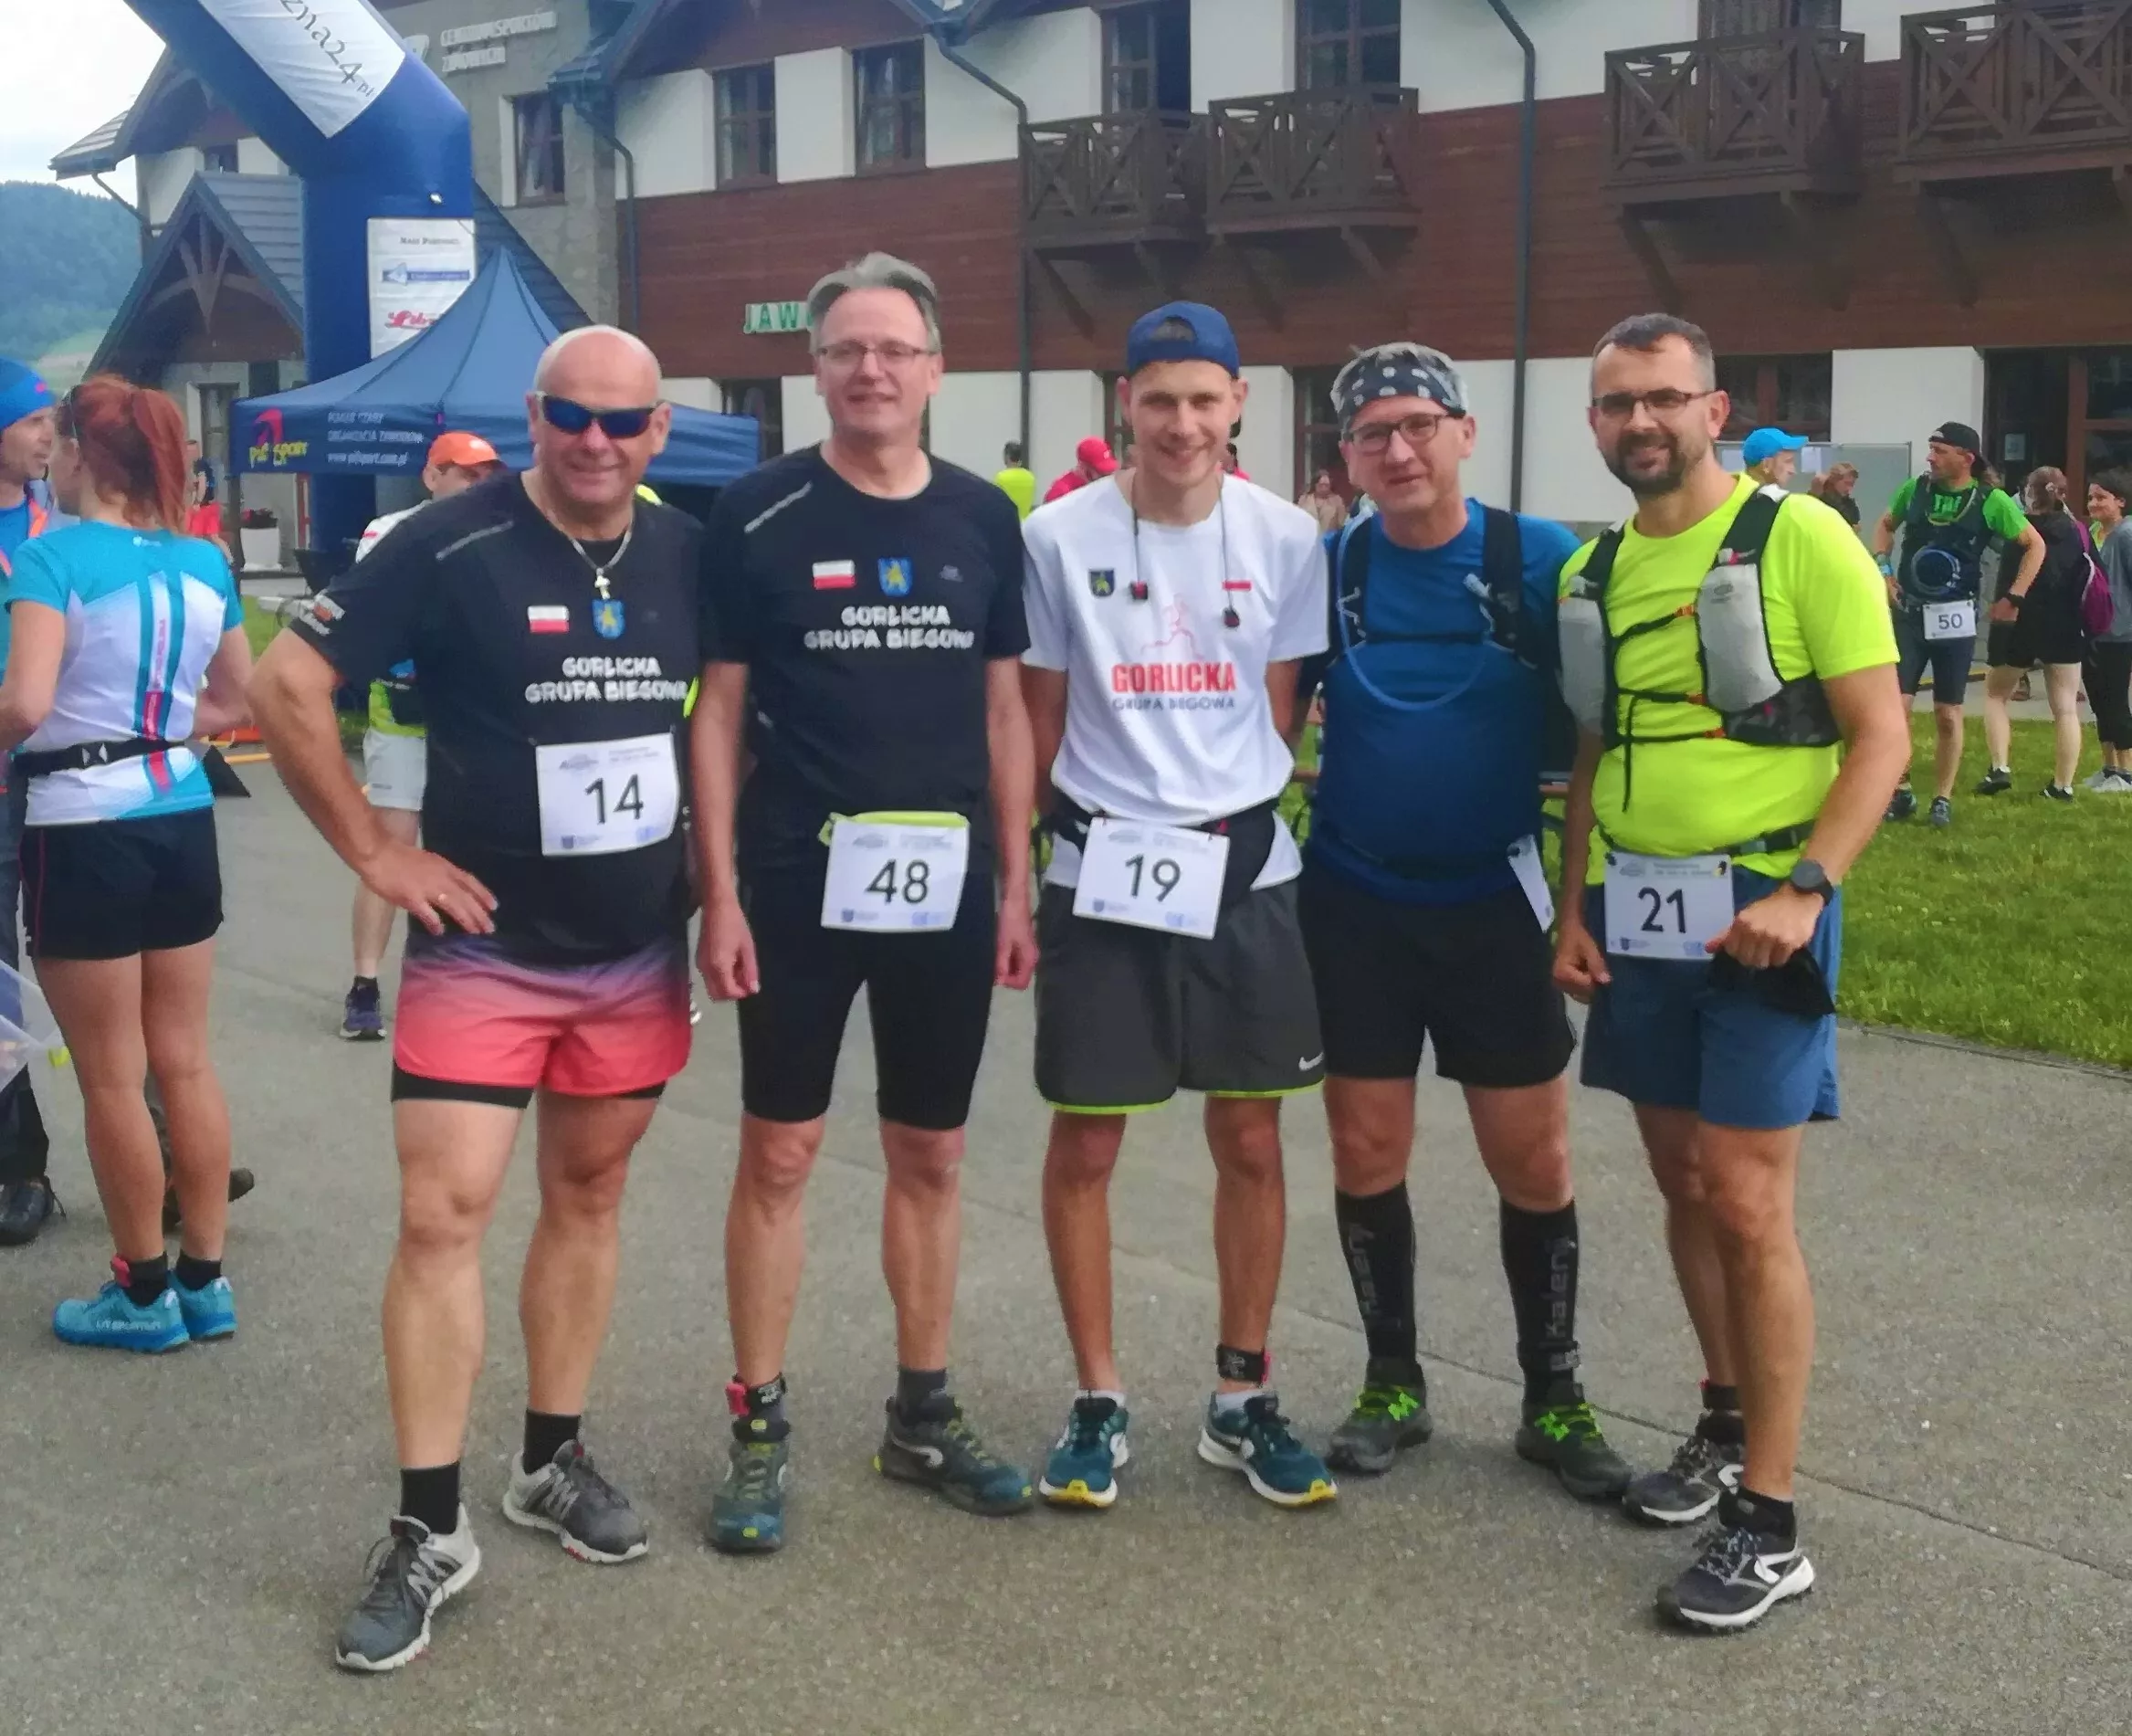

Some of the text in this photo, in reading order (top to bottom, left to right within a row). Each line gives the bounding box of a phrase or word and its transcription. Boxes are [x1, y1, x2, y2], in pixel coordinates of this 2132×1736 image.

[743, 301, 813, 333] JAW
[840, 605, 950, 626] GORLICKA
[1938, 613, 1962, 631] 50
[803, 628, 881, 650] GRUPA
[562, 657, 662, 679] GORLICKA
[1111, 661, 1237, 694] GORLICKA
[525, 679, 602, 703] GRUPA
[1112, 697, 1164, 710] GRUPA
[584, 773, 644, 825] 14
[865, 858, 929, 904] 48
[1125, 853, 1181, 903] 19
[1637, 887, 1687, 934] 21
